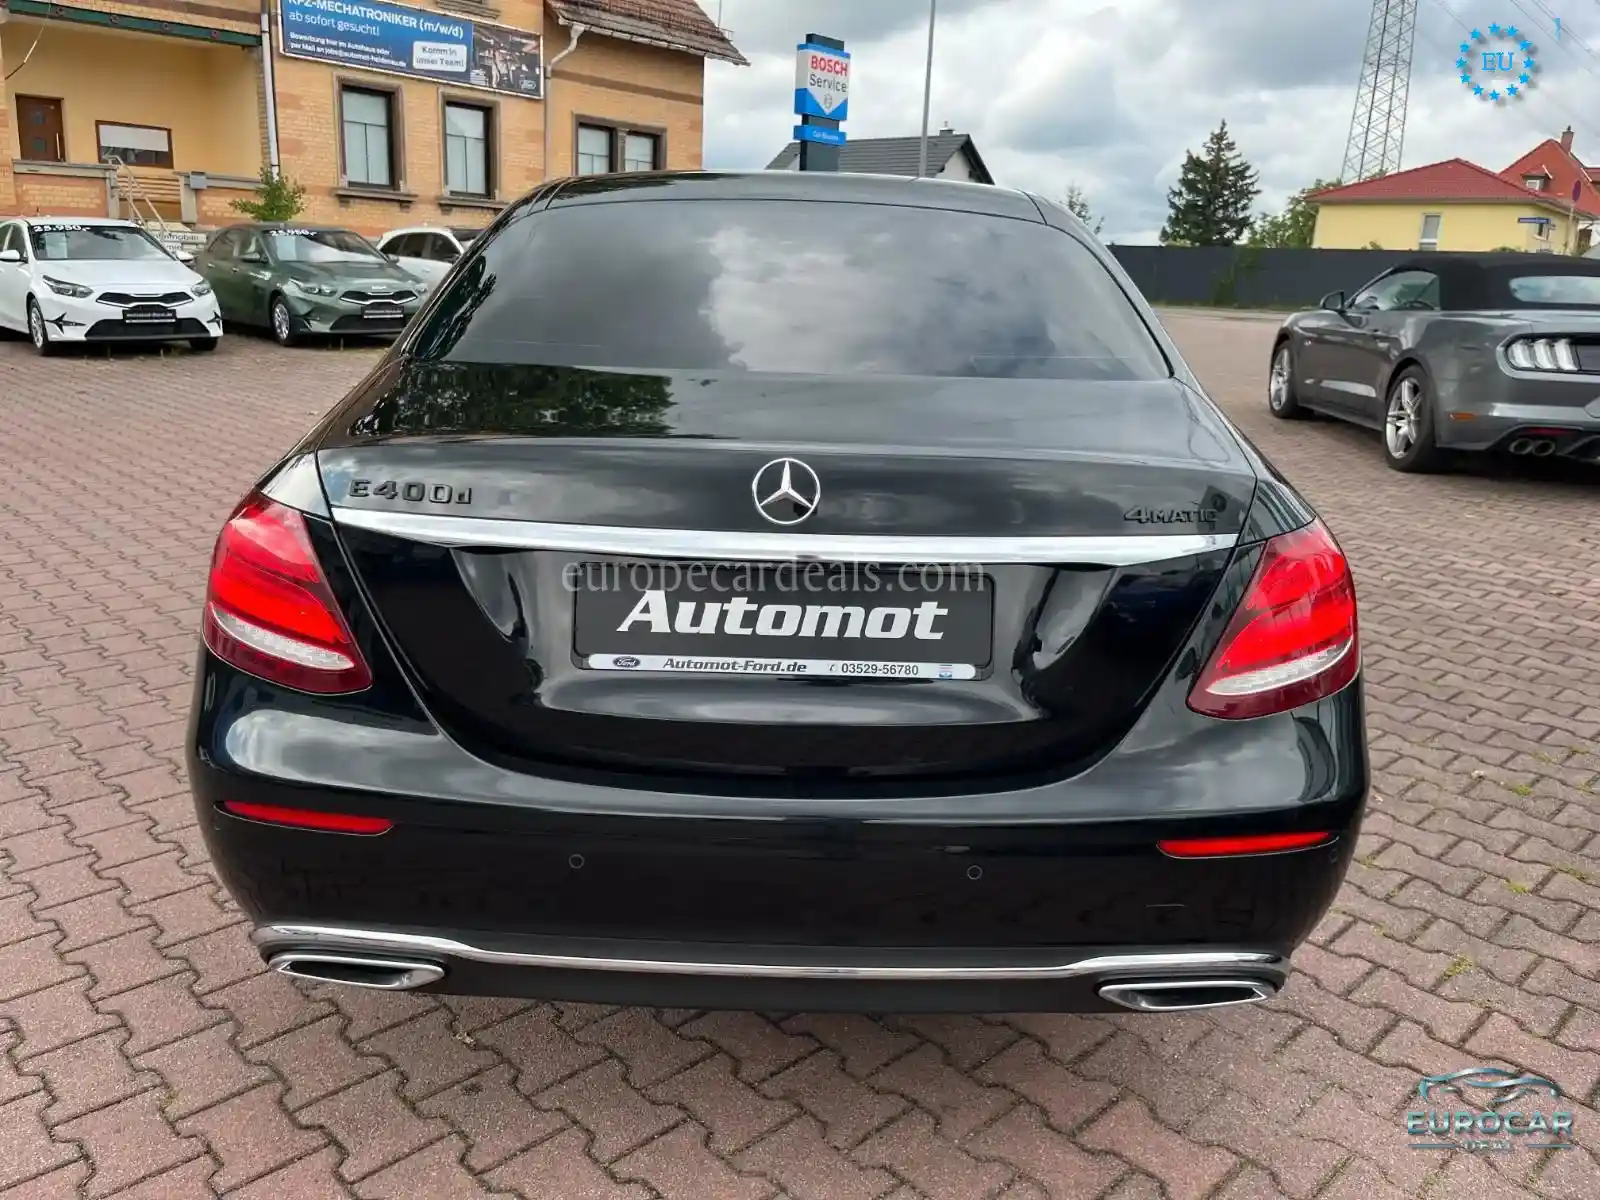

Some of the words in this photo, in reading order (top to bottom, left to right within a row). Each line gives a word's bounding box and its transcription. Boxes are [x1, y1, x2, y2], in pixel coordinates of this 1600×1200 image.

[288, 10, 303, 22] ab
[304, 14, 335, 29] sofort
[337, 20, 379, 38] gesucht!
[420, 18, 464, 40] (m/w/d)
[810, 55, 848, 76] BOSCH
[809, 73, 847, 93] Service
[616, 589, 949, 640] Automot
[663, 657, 807, 674] Automot-Ford.de
[841, 663, 919, 676] 03529-56780
